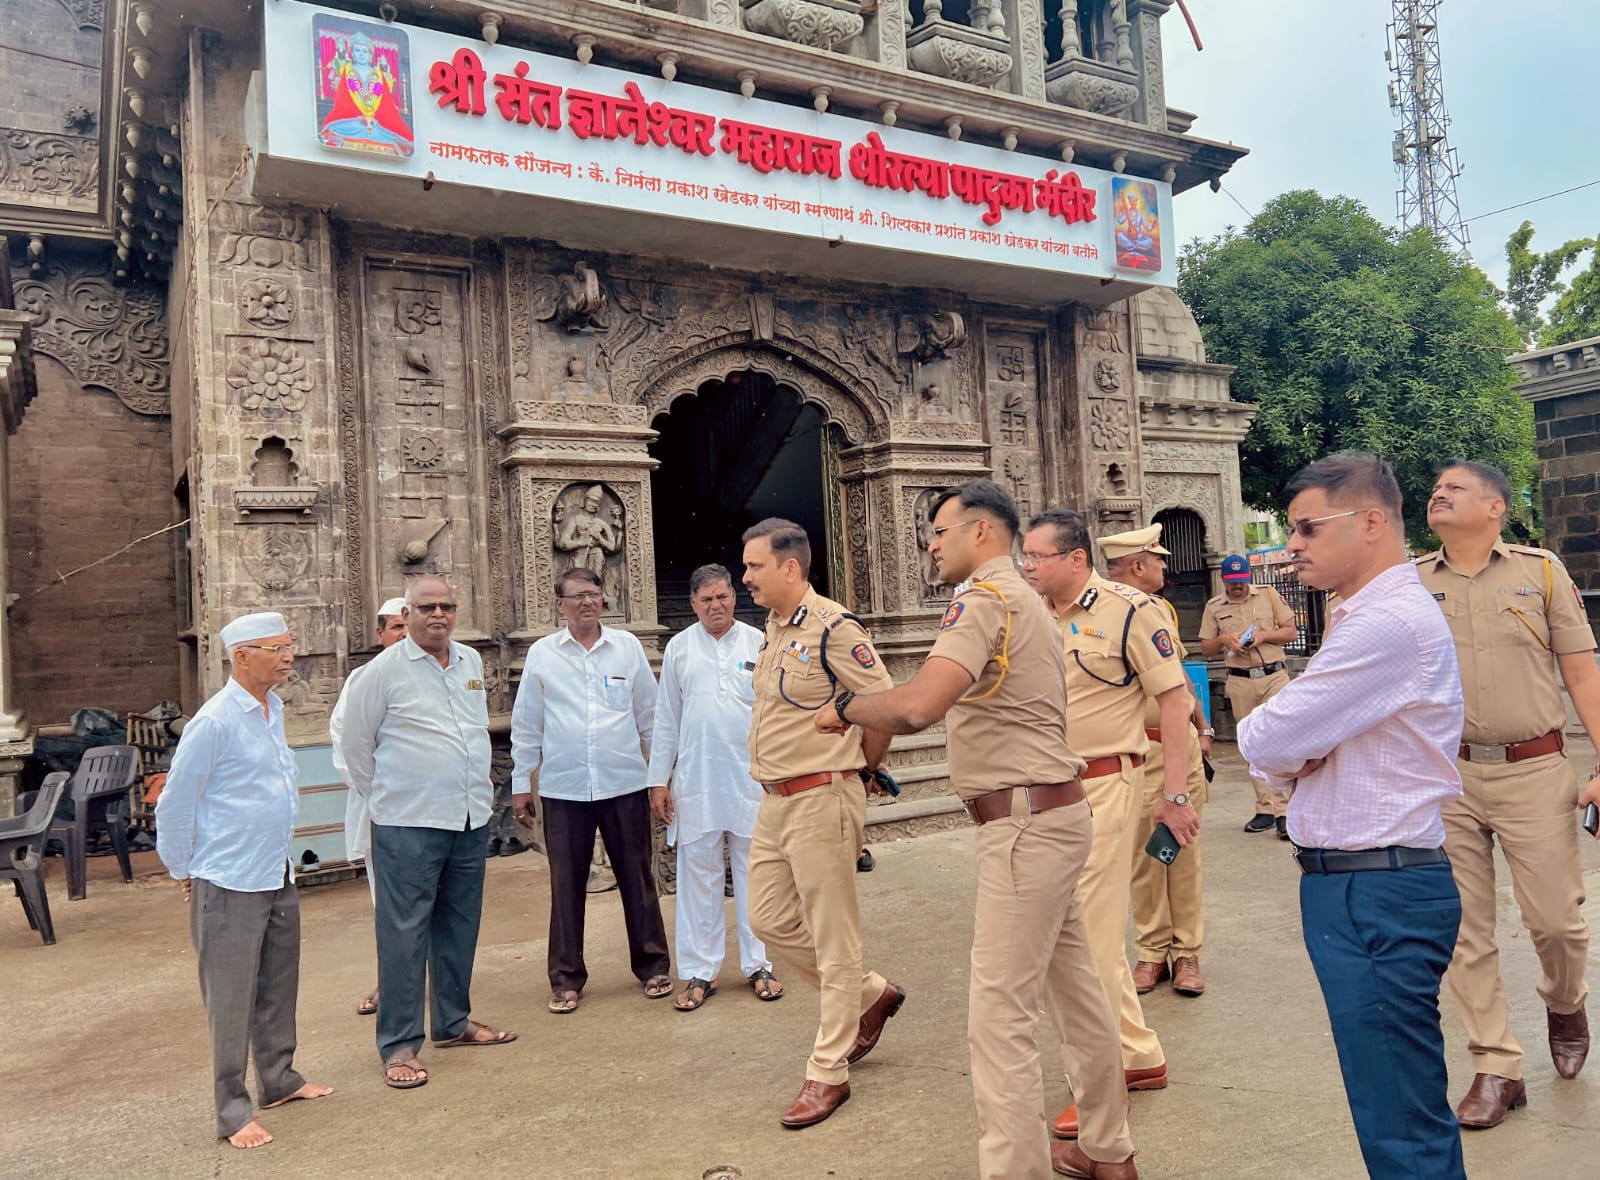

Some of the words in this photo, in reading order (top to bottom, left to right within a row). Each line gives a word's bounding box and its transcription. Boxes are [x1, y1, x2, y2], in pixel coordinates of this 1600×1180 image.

[429, 47, 487, 116] श्री
[493, 60, 563, 130] संत
[565, 81, 716, 157] ज्ञानेश्वर
[718, 117, 842, 180] महाराज
[848, 130, 950, 199] थोरल्या
[950, 163, 1035, 226] पादुका
[1035, 168, 1097, 224] मंदीर
[429, 141, 509, 167] नामफलक
[514, 150, 572, 178] सौजन्य
[615, 167, 661, 193] निर्मला
[666, 179, 708, 200] प्रकाश
[713, 184, 759, 208] खेडकर
[763, 193, 801, 215] यांच्या
[881, 212, 931, 236] शिल्पकार
[935, 222, 966, 241] प्रशांत
[969, 229, 1001, 246] प्रकाश
[1004, 231, 1039, 251] खेडकर
